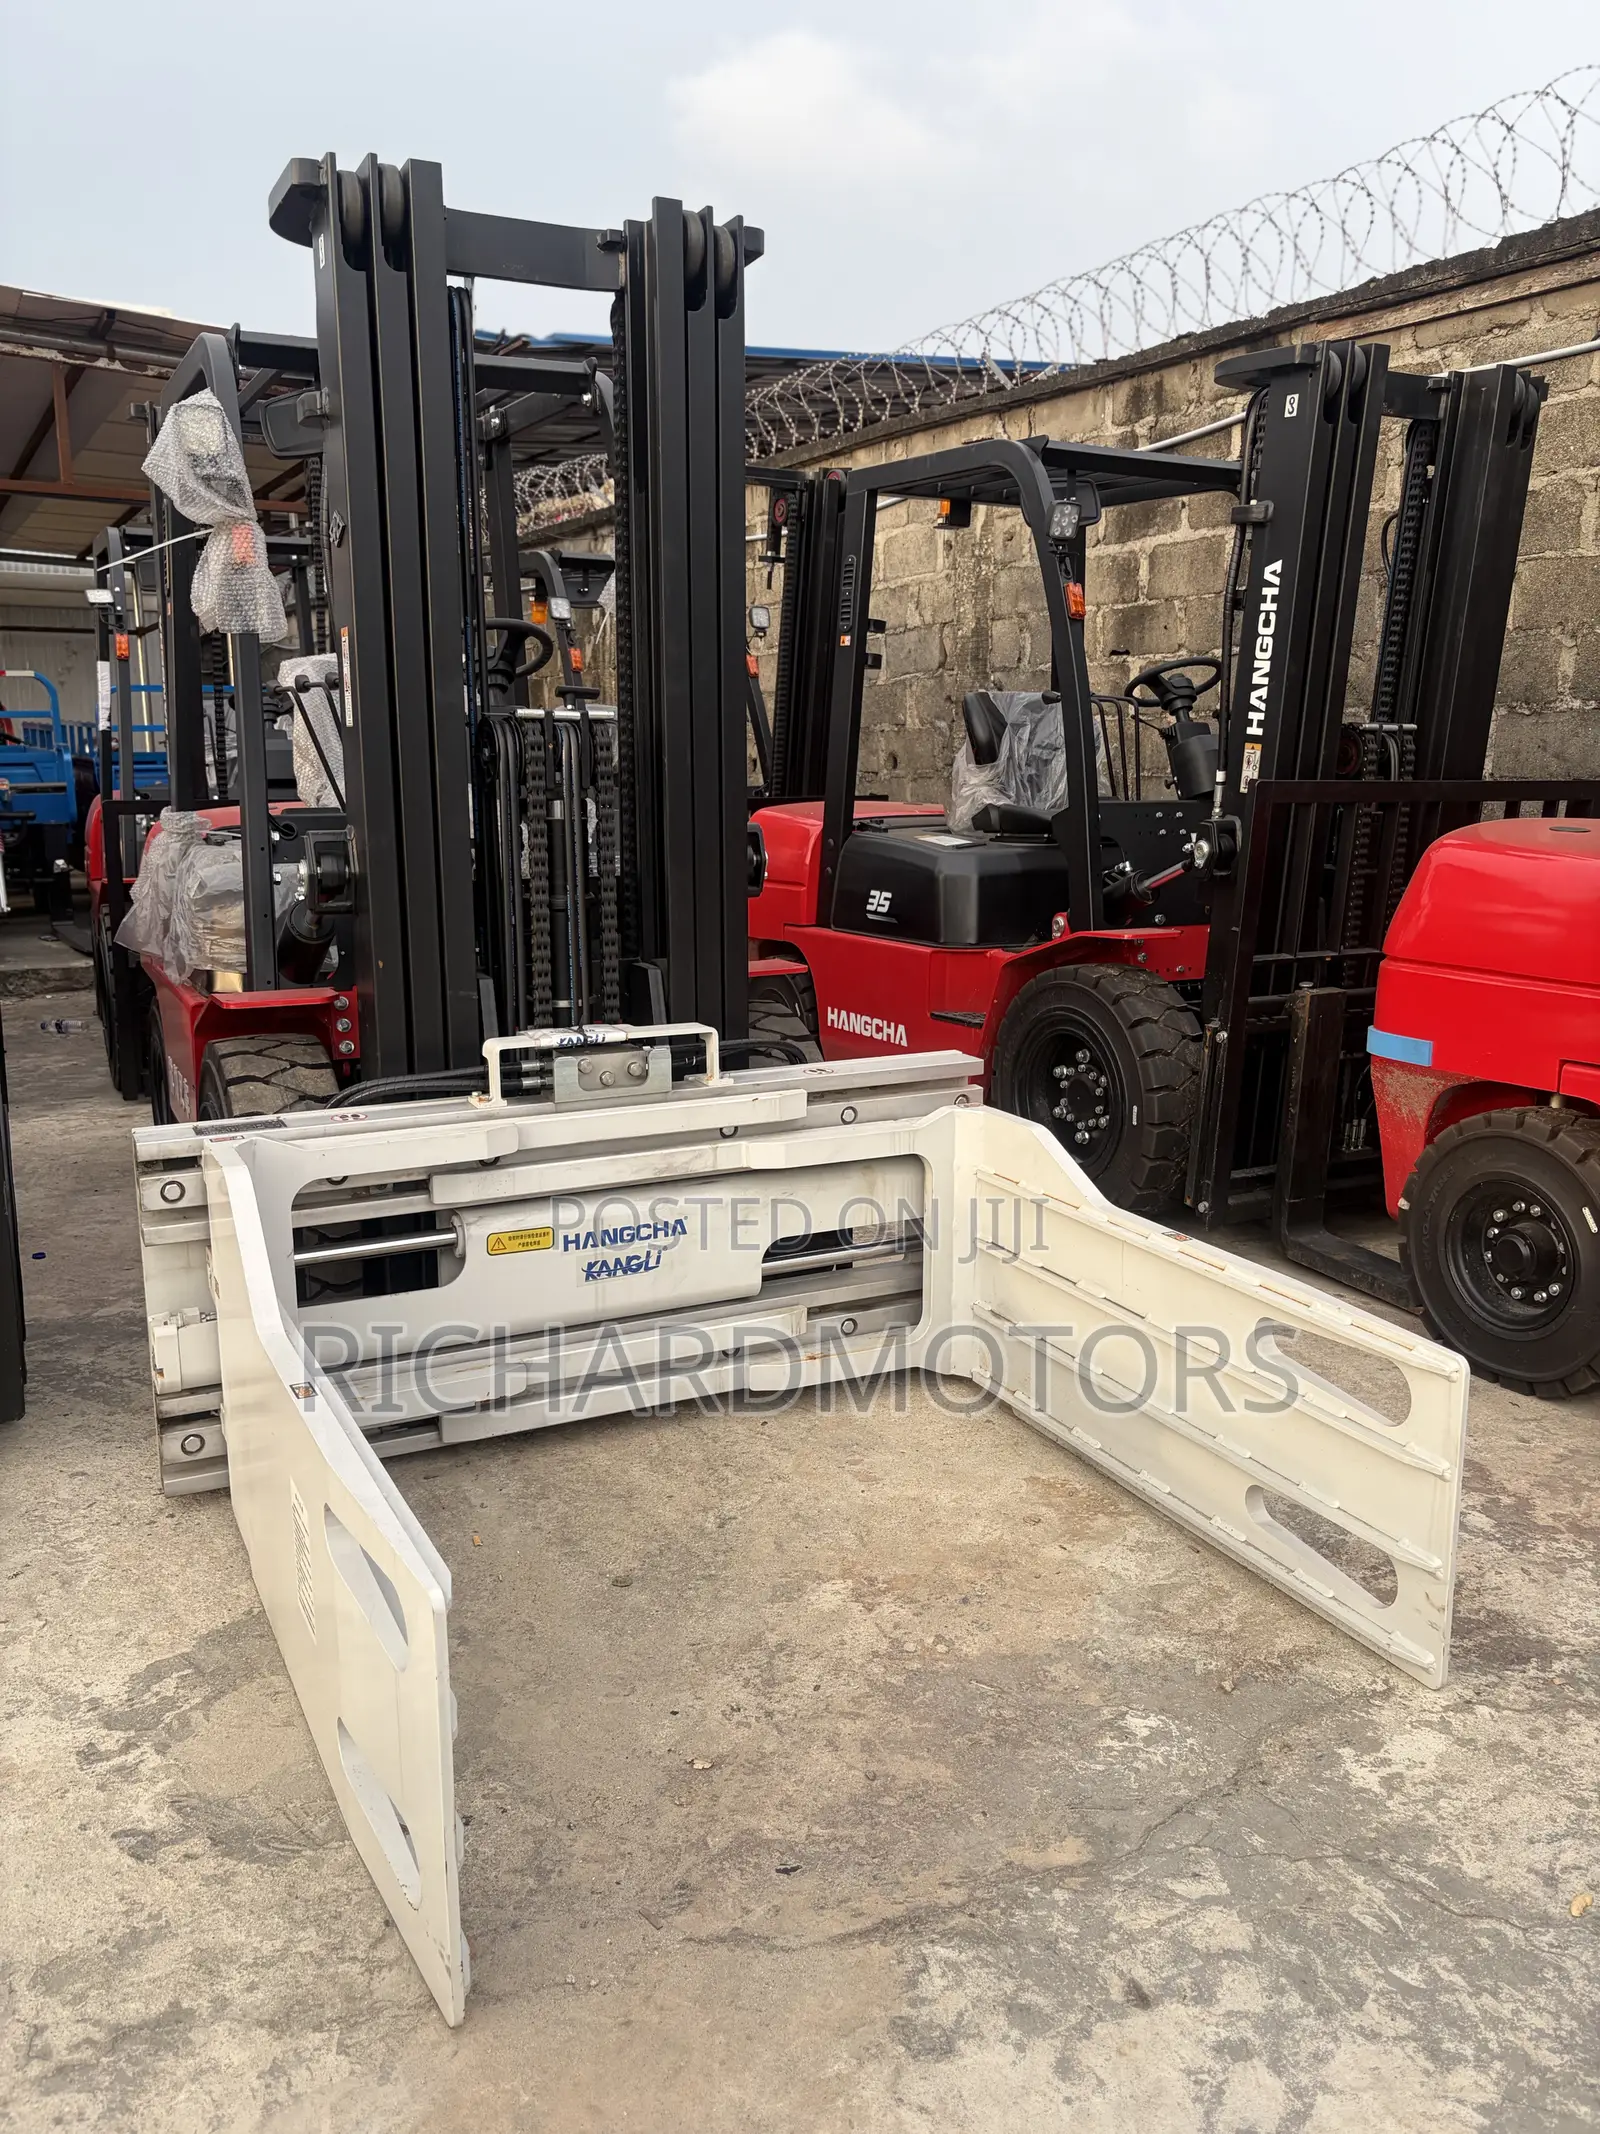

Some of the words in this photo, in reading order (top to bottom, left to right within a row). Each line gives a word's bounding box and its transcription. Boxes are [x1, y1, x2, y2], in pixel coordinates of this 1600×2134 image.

[1246, 559, 1283, 736] HANGCHA
[866, 889, 892, 913] 35
[827, 1006, 908, 1047] HANGCHA
[563, 1218, 688, 1252] HANGCHA
